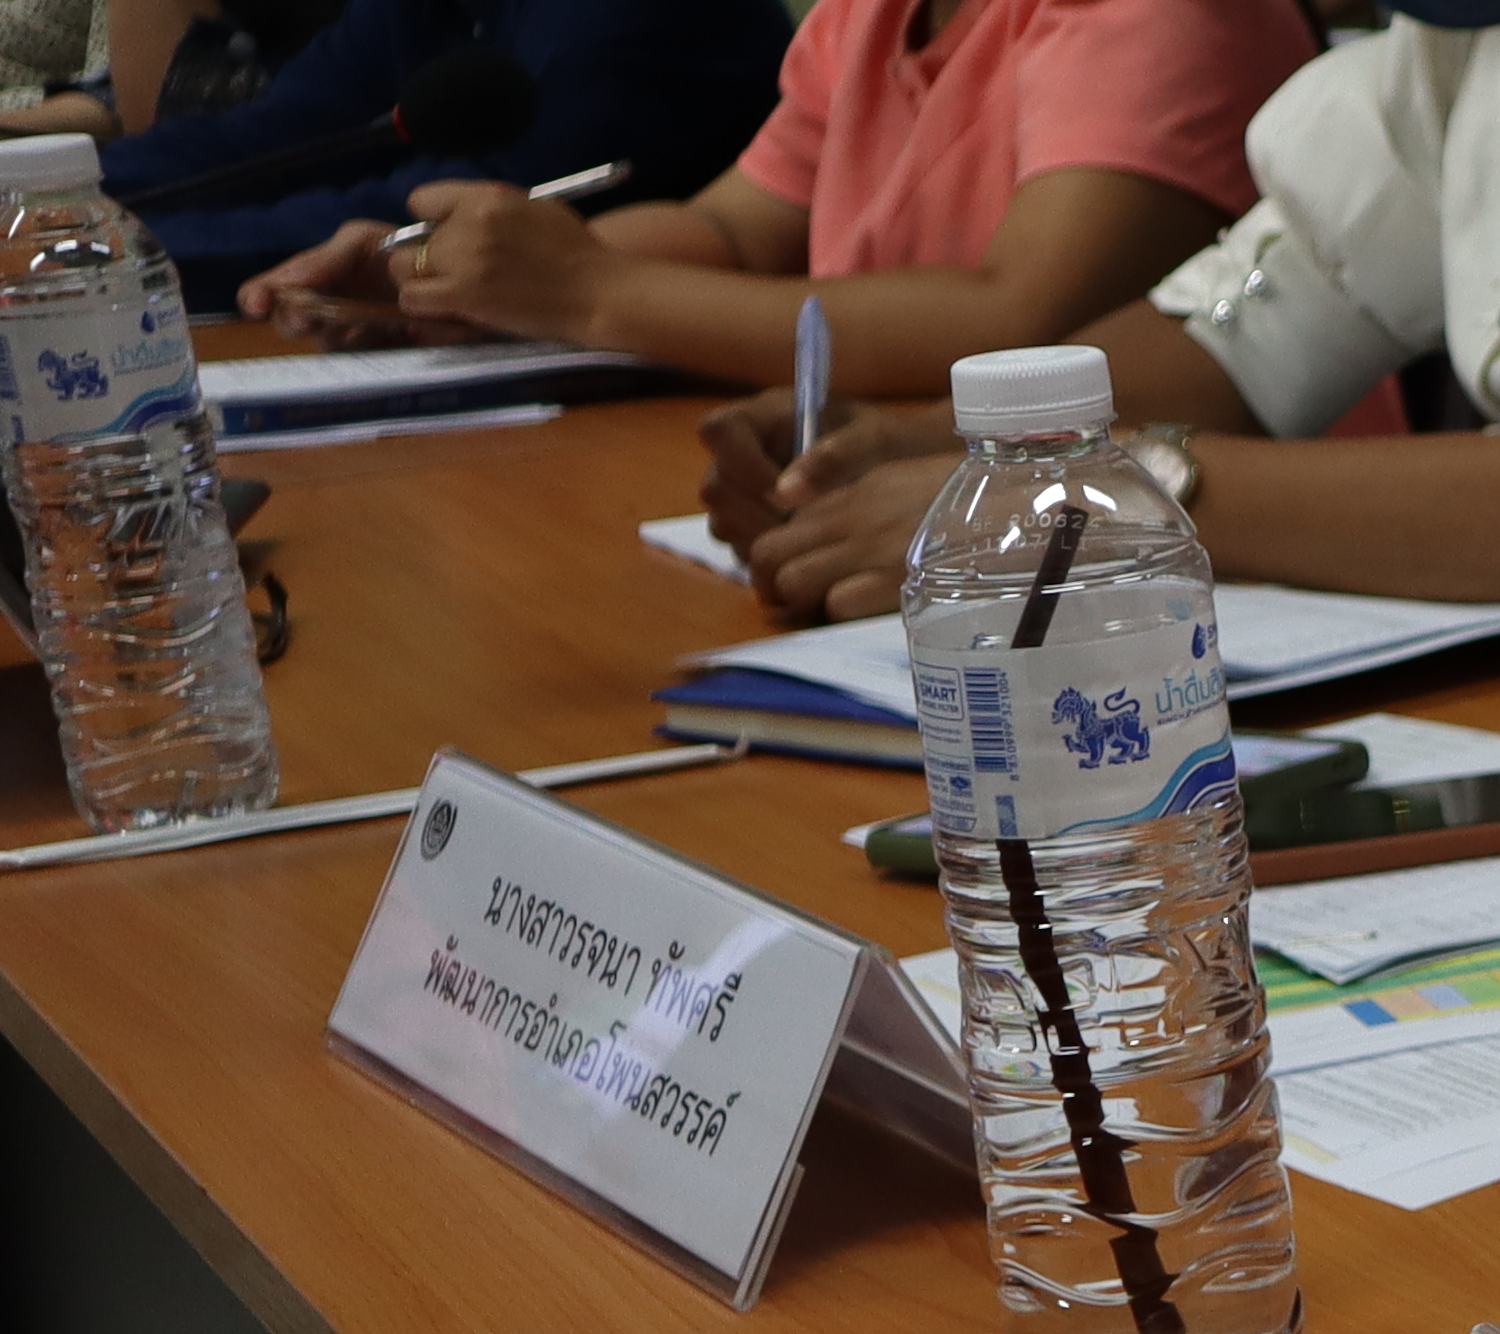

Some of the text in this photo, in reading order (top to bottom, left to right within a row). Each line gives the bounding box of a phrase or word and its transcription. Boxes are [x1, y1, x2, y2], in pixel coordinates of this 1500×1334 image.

[920, 684, 957, 702] SMART
[484, 875, 641, 997] นางสาวรจนา
[425, 933, 743, 1157] พัฒนาการอำเภอโพนสวรรค์
